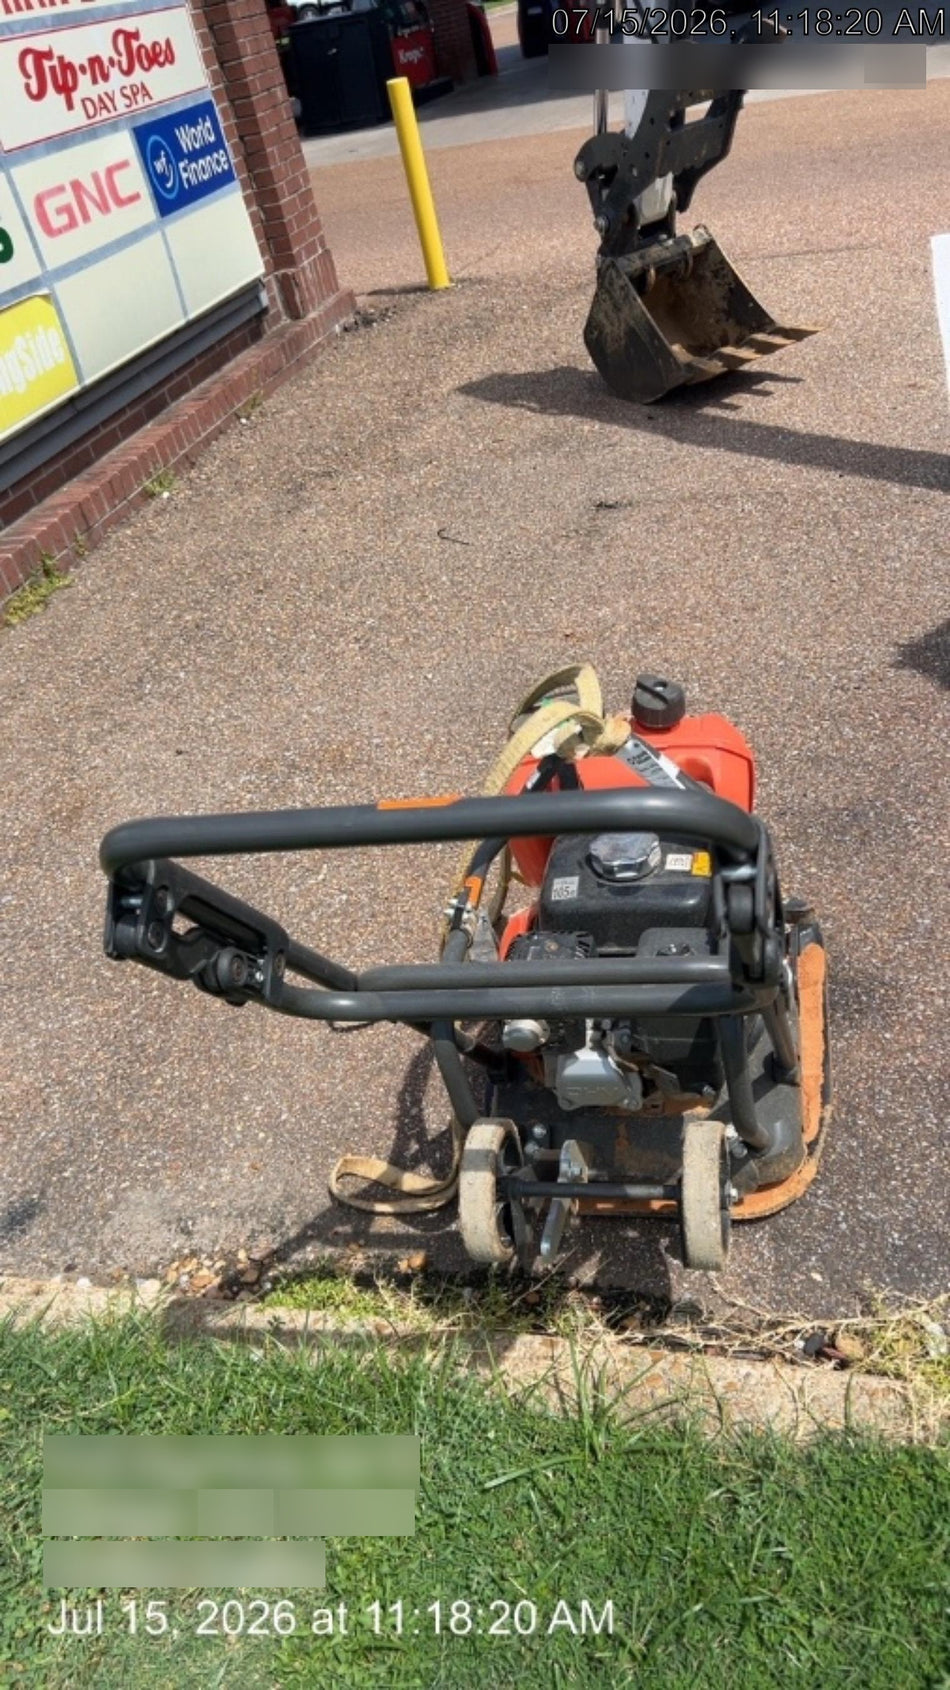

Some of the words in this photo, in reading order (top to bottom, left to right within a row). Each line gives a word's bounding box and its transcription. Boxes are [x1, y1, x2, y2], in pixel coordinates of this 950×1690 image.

[80, 92, 118, 120] DAY
[120, 81, 153, 107] SPA
[174, 115, 215, 154] World
[178, 149, 229, 189] Finance
[34, 159, 141, 239] GNC
